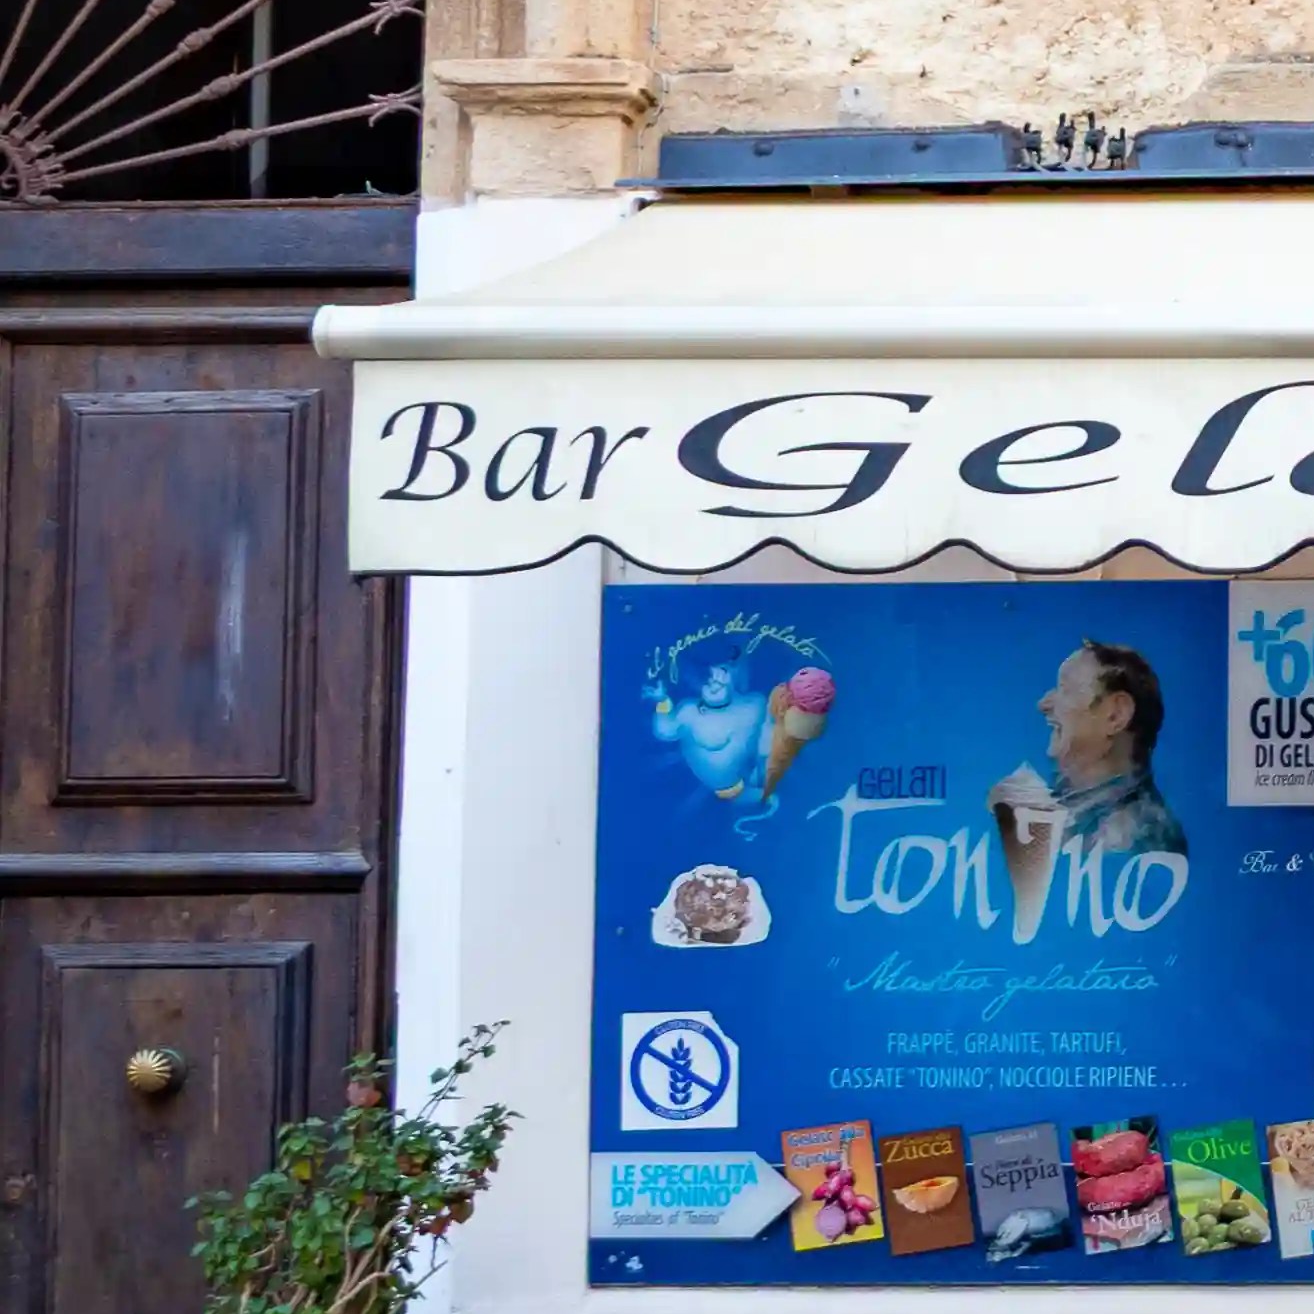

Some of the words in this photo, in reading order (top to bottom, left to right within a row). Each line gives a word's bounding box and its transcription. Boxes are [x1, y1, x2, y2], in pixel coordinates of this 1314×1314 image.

[379, 400, 650, 502] Bar
[1255, 744, 1273, 768] DI
[1286, 854, 1303, 873] &
[964, 1032, 1045, 1057] GRANITE,
[1050, 1031, 1127, 1056] TARTUFI,
[829, 1067, 905, 1089] CASSATE
[999, 1066, 1086, 1089] NOCCIOLE
[884, 1139, 956, 1163] Zucca
[1187, 1136, 1253, 1164] Olive
[611, 1163, 637, 1185] LE
[640, 1159, 759, 1185] SPECIALITÀ
[980, 1158, 1059, 1194] Seppia
[611, 1187, 635, 1208] DI
